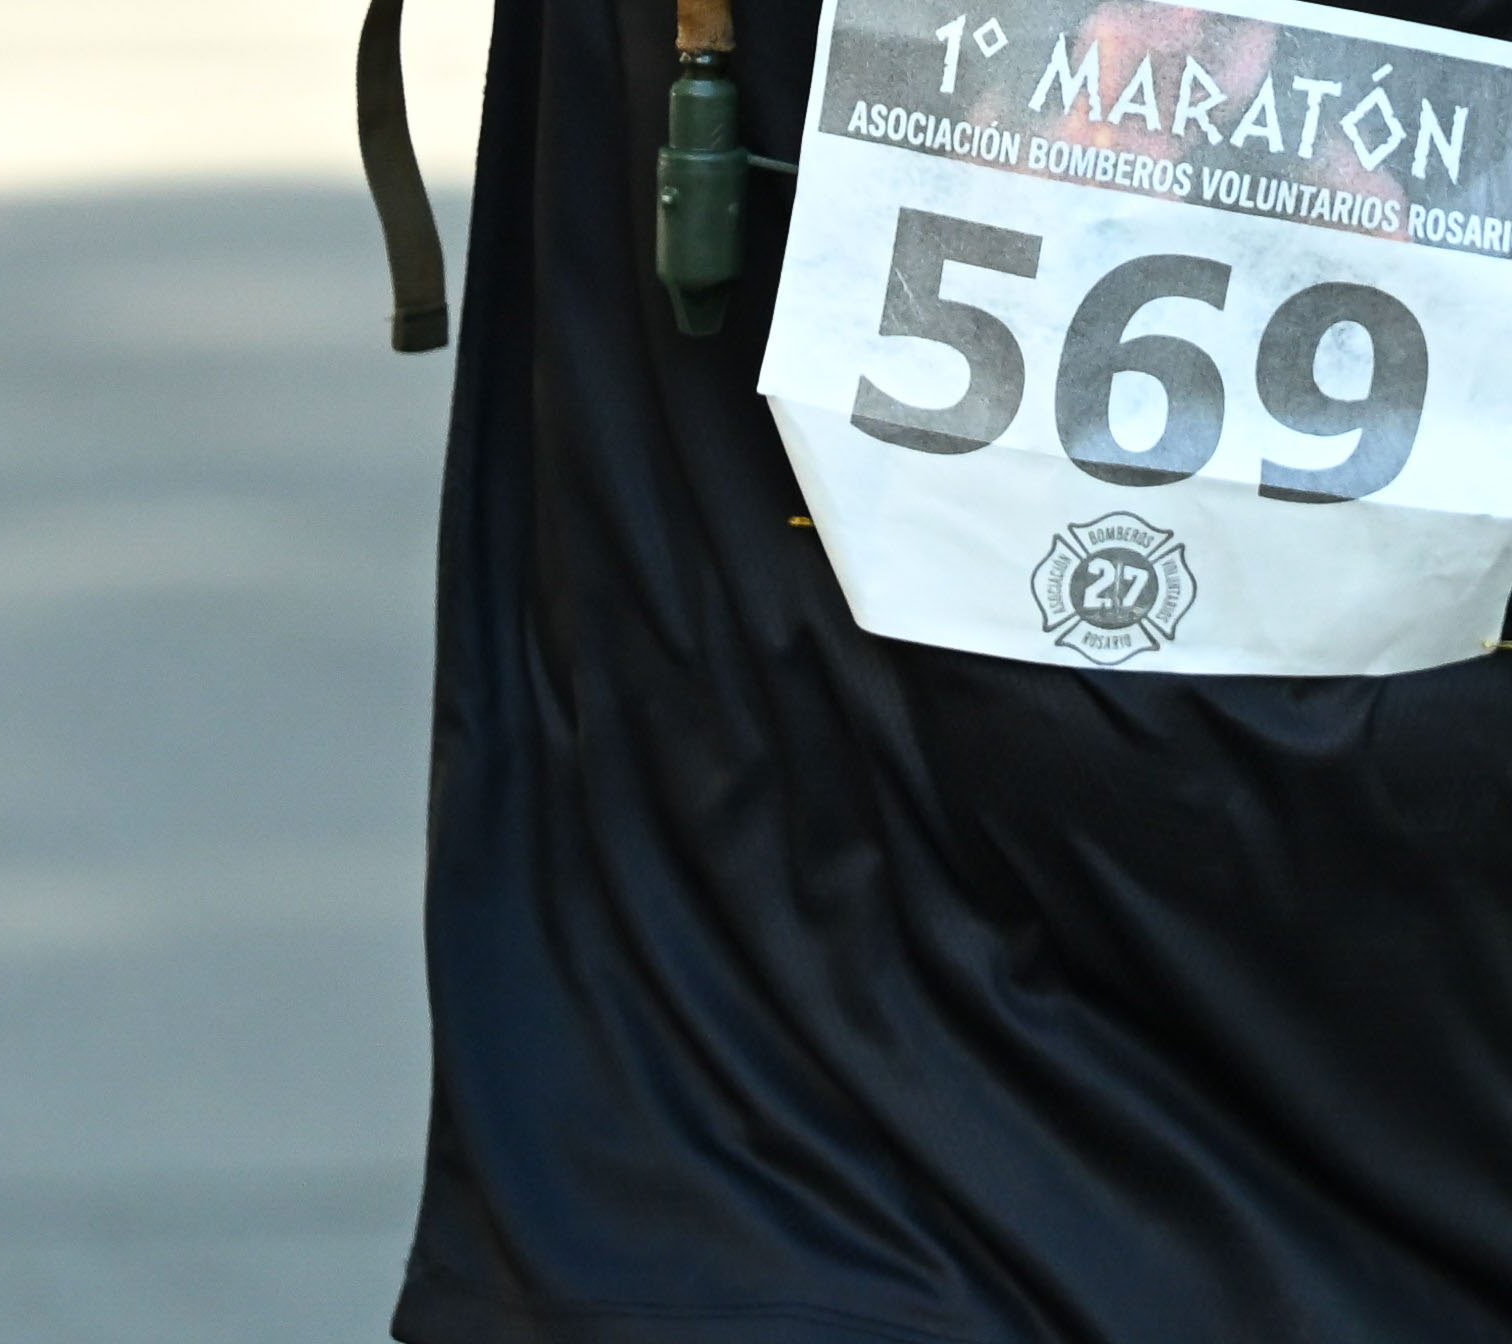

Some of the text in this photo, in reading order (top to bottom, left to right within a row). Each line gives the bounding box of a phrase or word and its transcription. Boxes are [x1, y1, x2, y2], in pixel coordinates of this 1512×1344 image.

[1027, 30, 1469, 186] MARATÓN
[846, 99, 1022, 164] ASOCIACIÓN
[1027, 136, 1193, 198] BOMBEROS
[1200, 169, 1402, 234] VOLUNTARIOS
[849, 206, 1430, 505] 569
[1082, 557, 1150, 609] 27
[1088, 525, 1155, 549] BOMBEROS
[1081, 630, 1132, 650] ROSARIO
